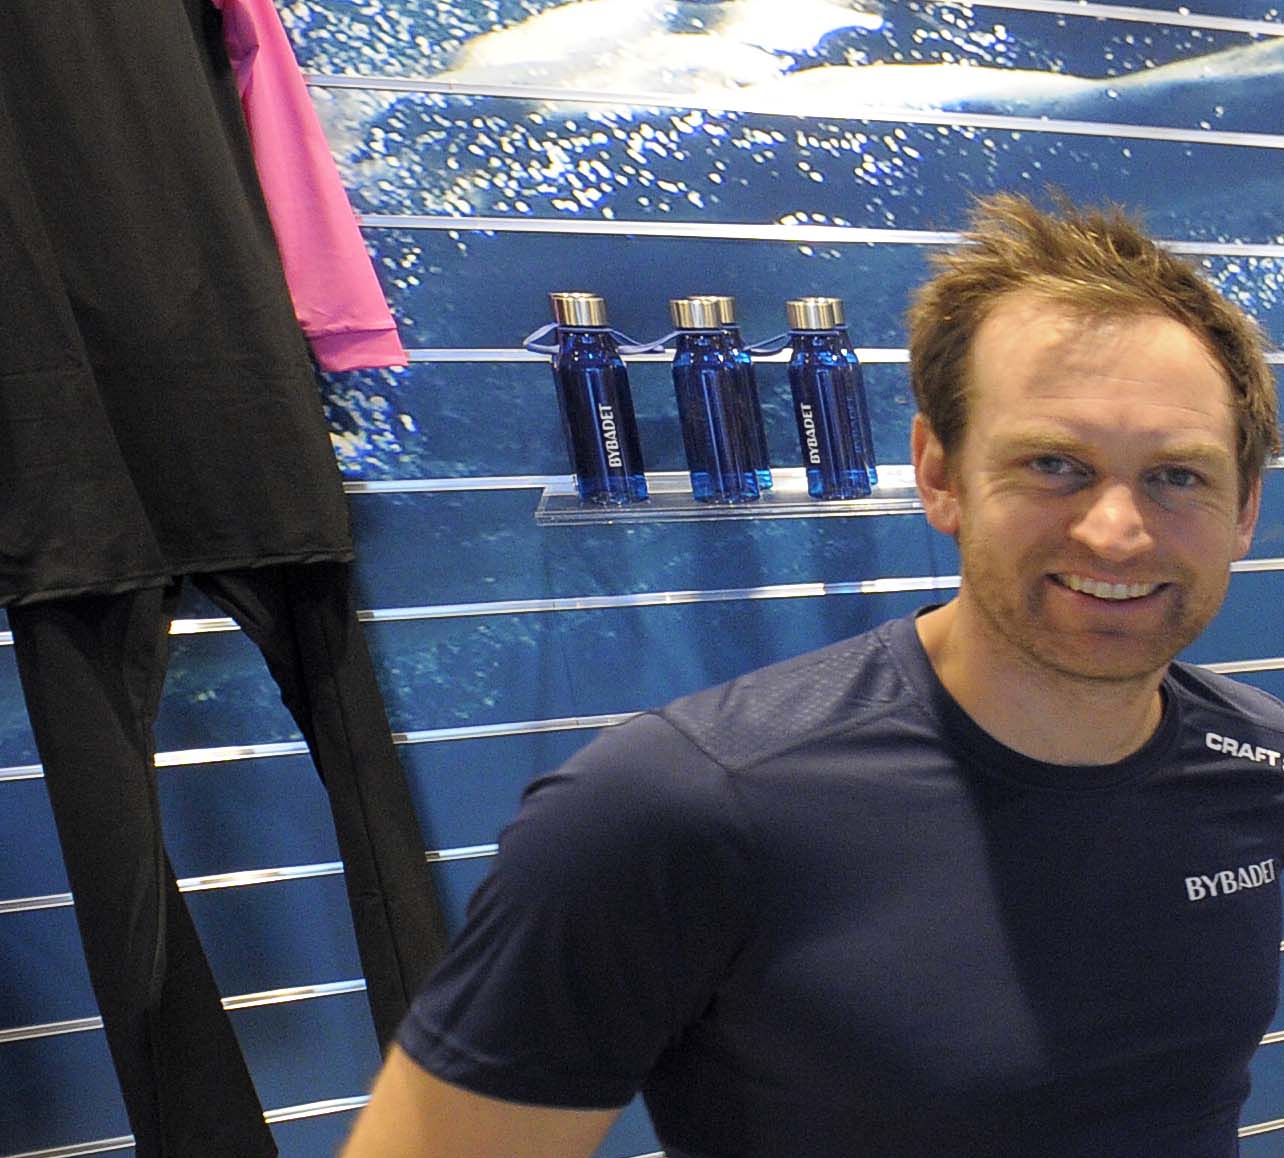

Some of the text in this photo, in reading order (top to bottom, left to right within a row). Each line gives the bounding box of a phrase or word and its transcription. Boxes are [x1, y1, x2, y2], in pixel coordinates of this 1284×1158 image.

[599, 403, 622, 467] BYBADET
[801, 402, 821, 464] BYBADET
[1205, 732, 1281, 767] CRAFT
[1185, 858, 1276, 901] BYBADET
